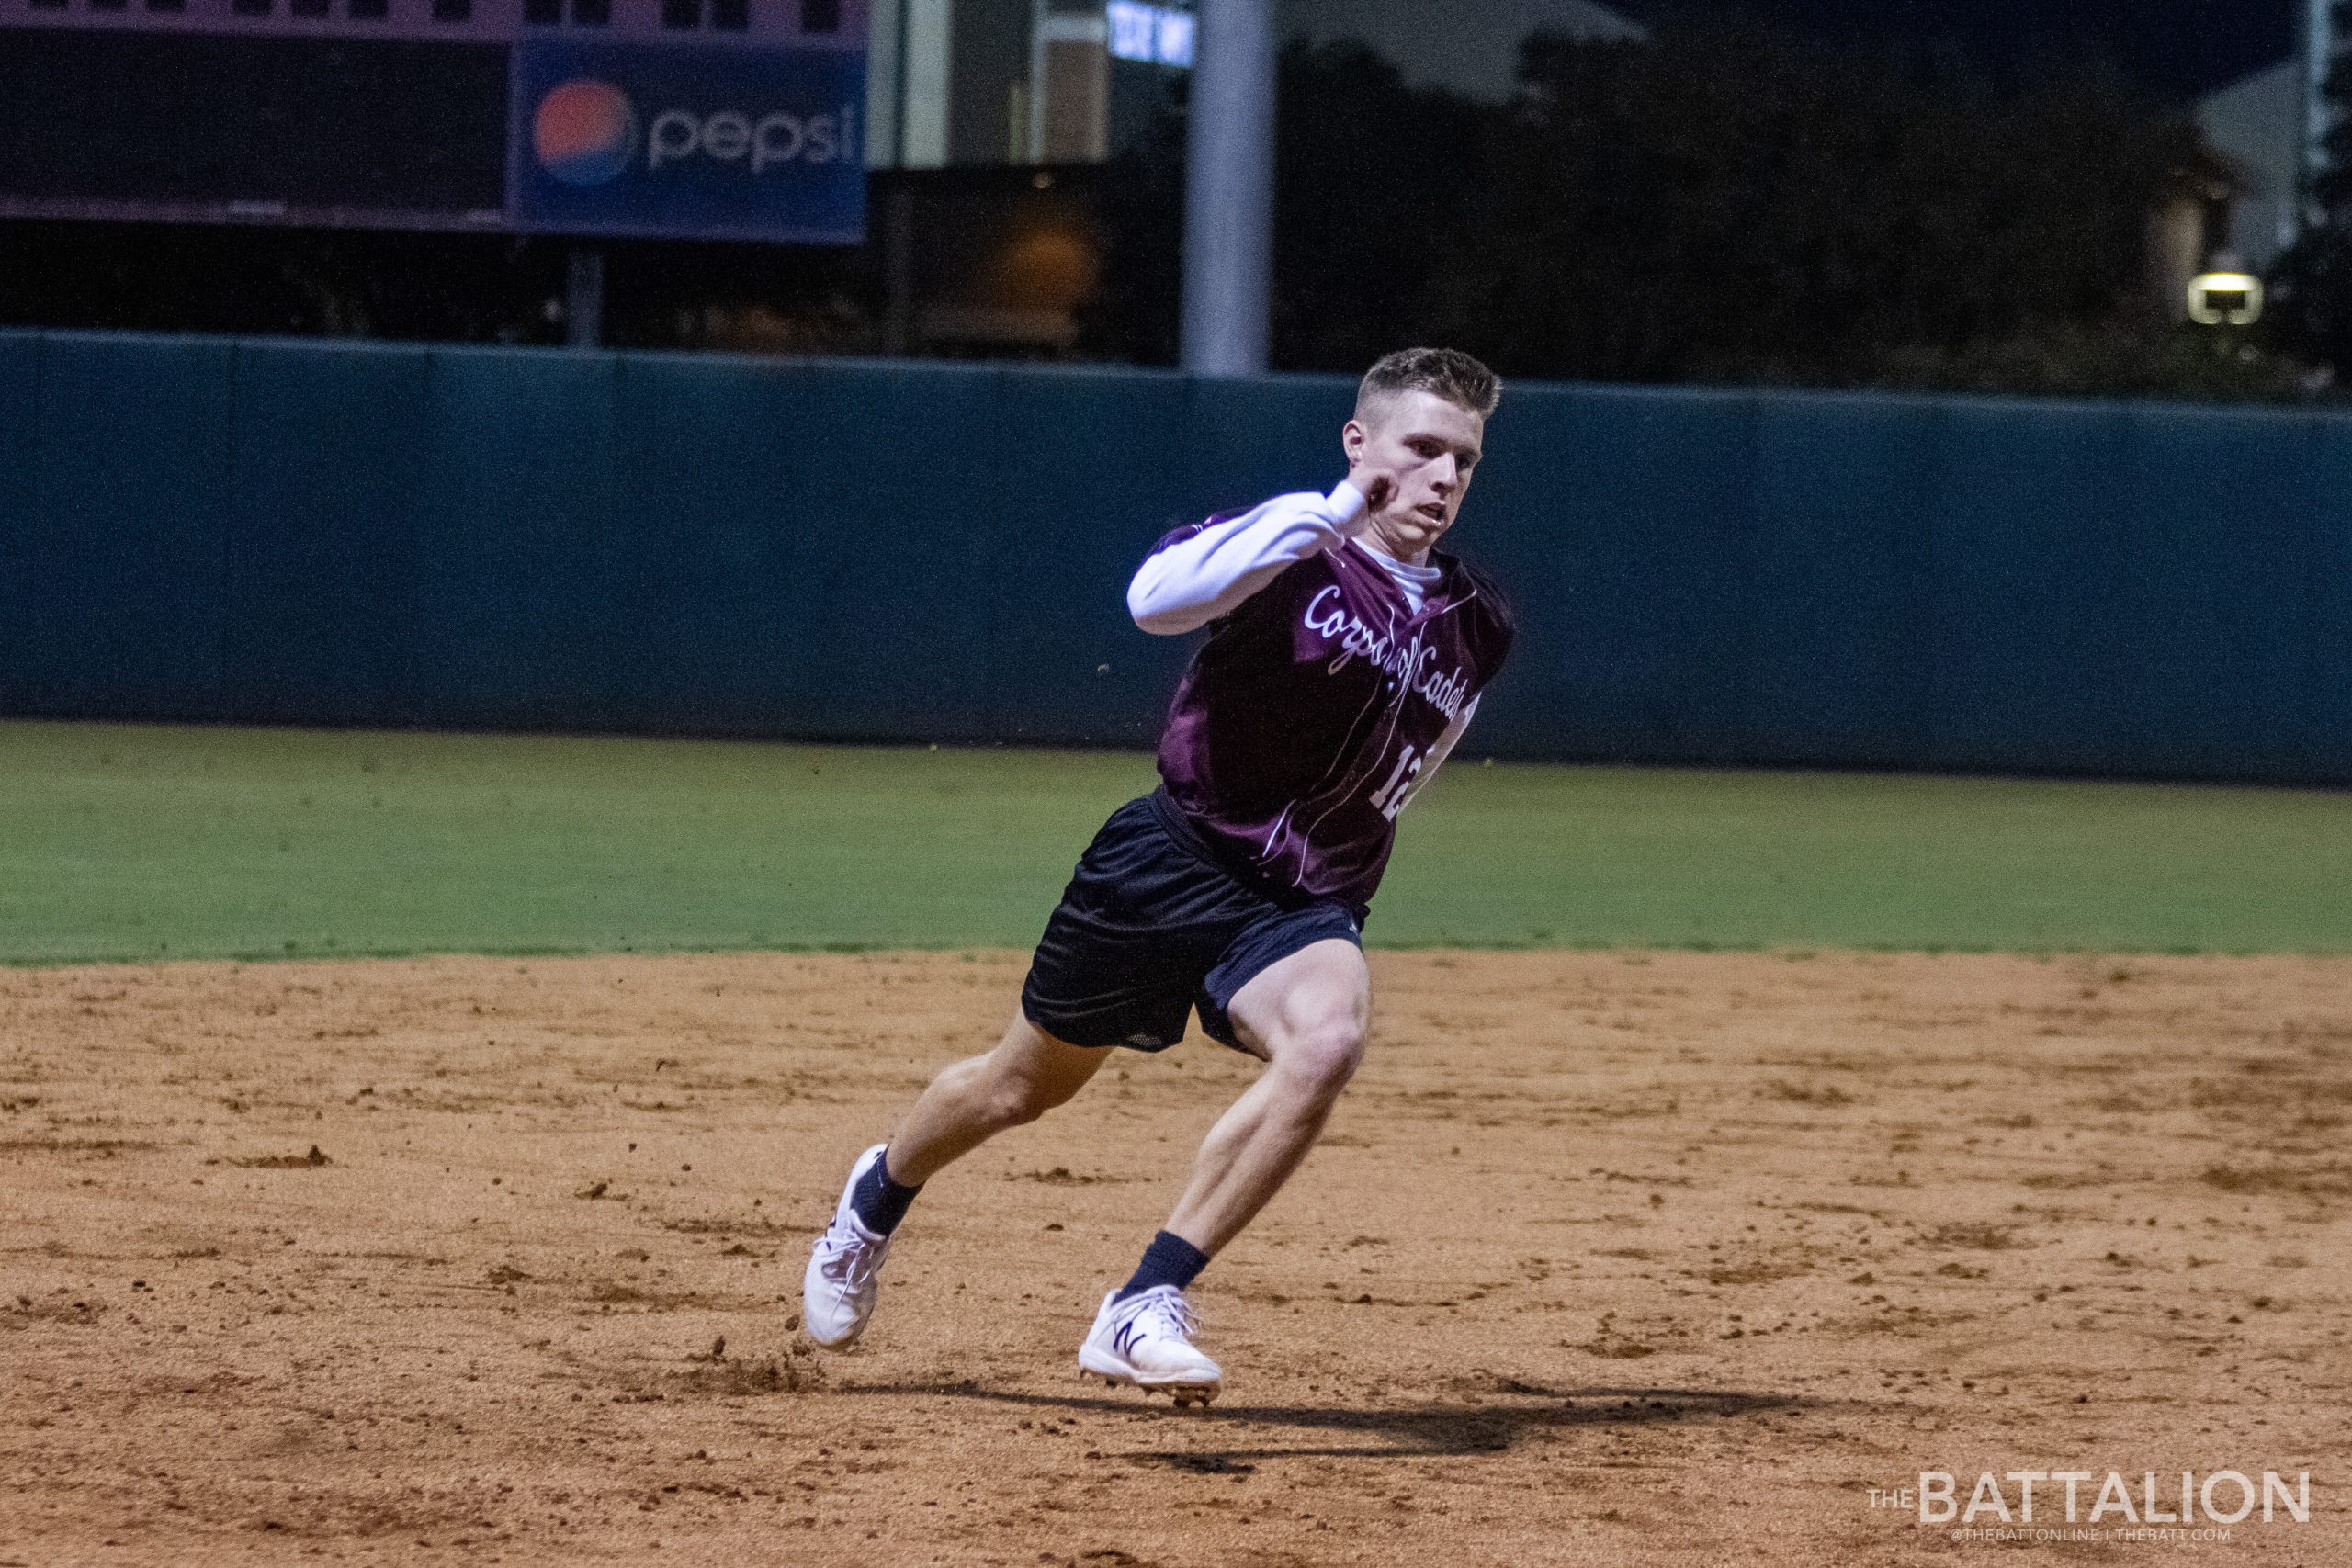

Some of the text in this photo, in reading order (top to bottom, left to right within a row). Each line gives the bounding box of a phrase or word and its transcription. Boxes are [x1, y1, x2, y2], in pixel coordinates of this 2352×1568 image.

[647, 104, 855, 175] pepsi
[1304, 584, 1389, 676] Corps
[1368, 744, 1423, 823] 12
